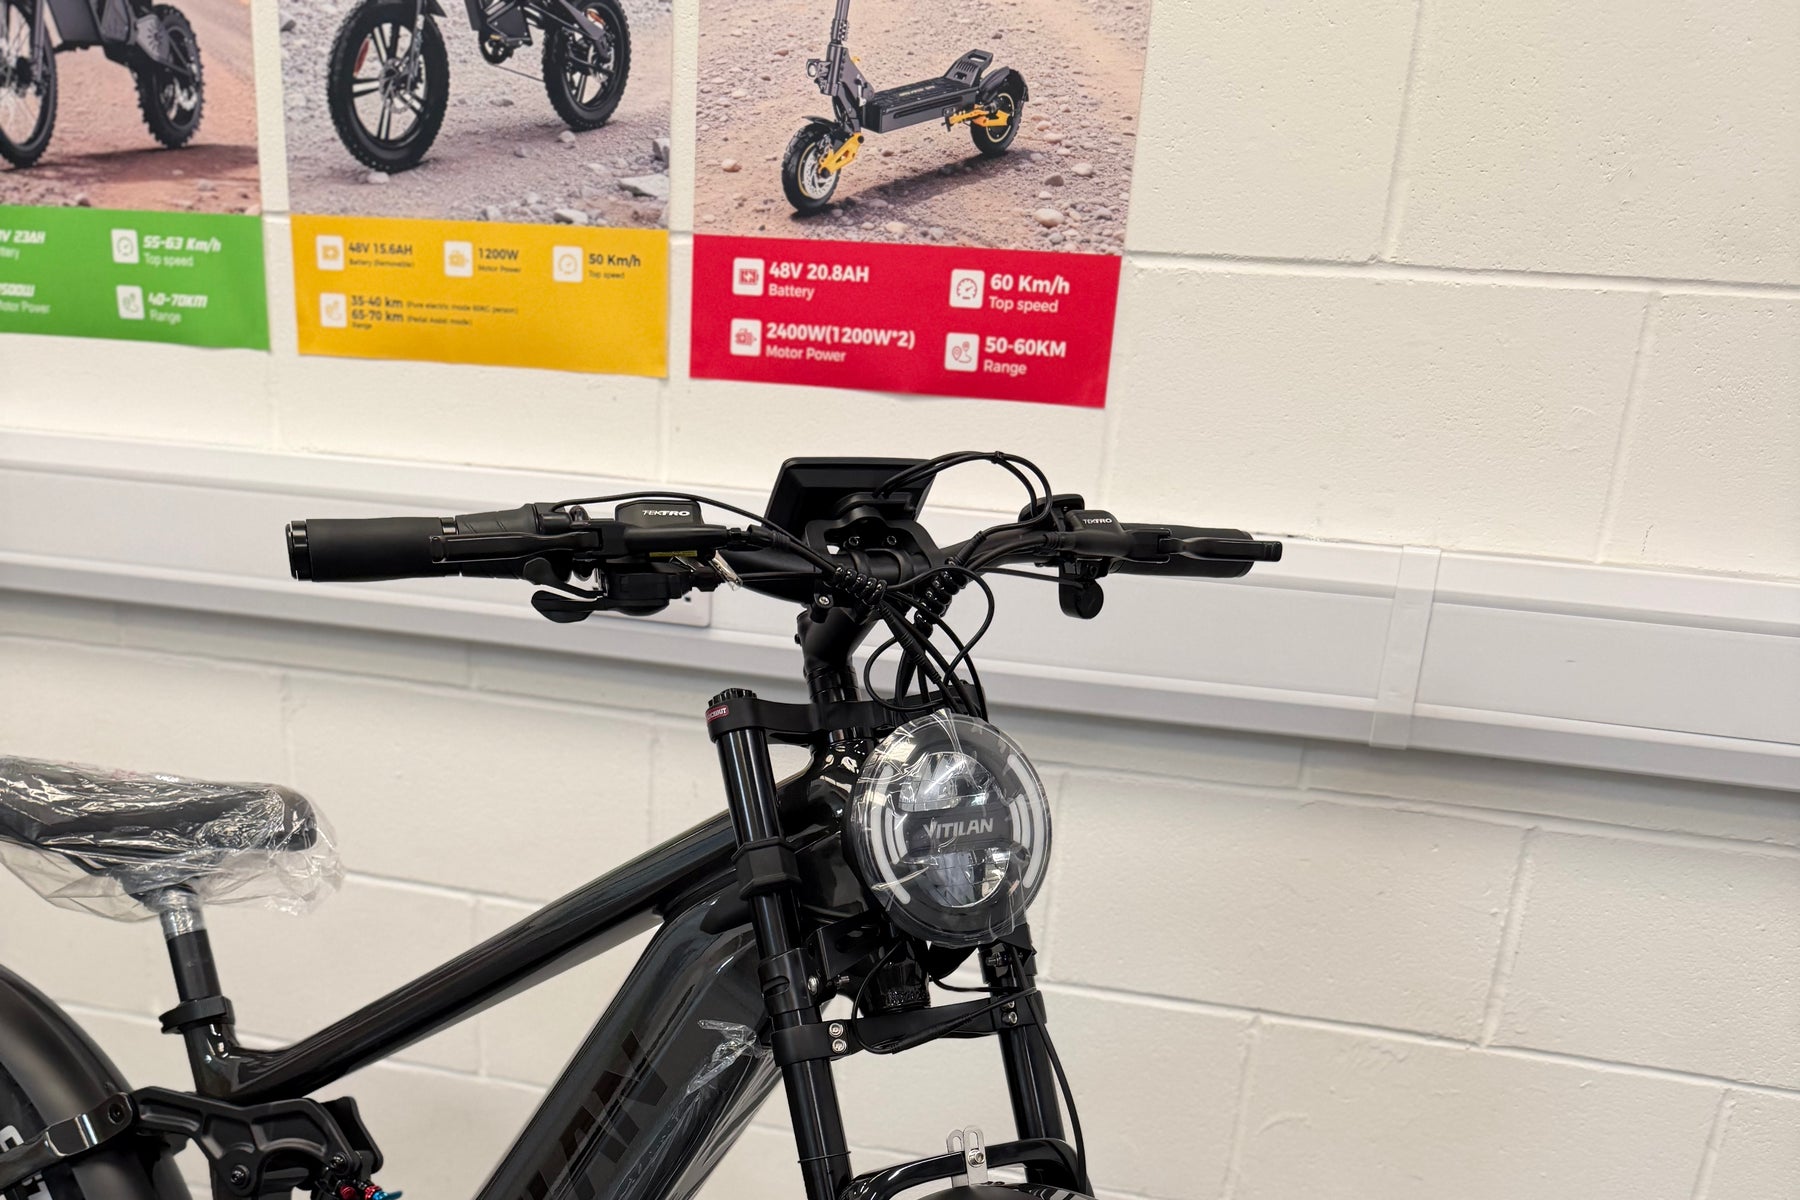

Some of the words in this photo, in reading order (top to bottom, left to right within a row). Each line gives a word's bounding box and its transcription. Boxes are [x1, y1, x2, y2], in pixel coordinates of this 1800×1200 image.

[143, 235, 184, 251] 55-63
[186, 238, 222, 253] Km/h
[348, 242, 369, 254] 48V
[373, 243, 413, 256] 15.6AH
[143, 253, 162, 266] Top
[163, 254, 194, 267] speed
[478, 248, 519, 261] 1200W
[588, 253, 604, 266] 50
[607, 254, 642, 268] Km/h
[768, 262, 803, 280] 48V
[806, 264, 870, 283] 20.8AH
[768, 283, 815, 301] Battery
[990, 274, 1014, 291] 60
[1017, 275, 1071, 296] Km/h
[385, 297, 404, 309] km
[989, 296, 1014, 312] Top
[1016, 298, 1059, 314] speed
[149, 309, 182, 324] Range
[385, 311, 404, 323] km
[765, 344, 804, 361] Motor
[806, 346, 846, 363] Power
[984, 336, 1067, 358] 50-60KM
[983, 359, 1027, 376] Range
[923, 817, 994, 840] VITILAN
